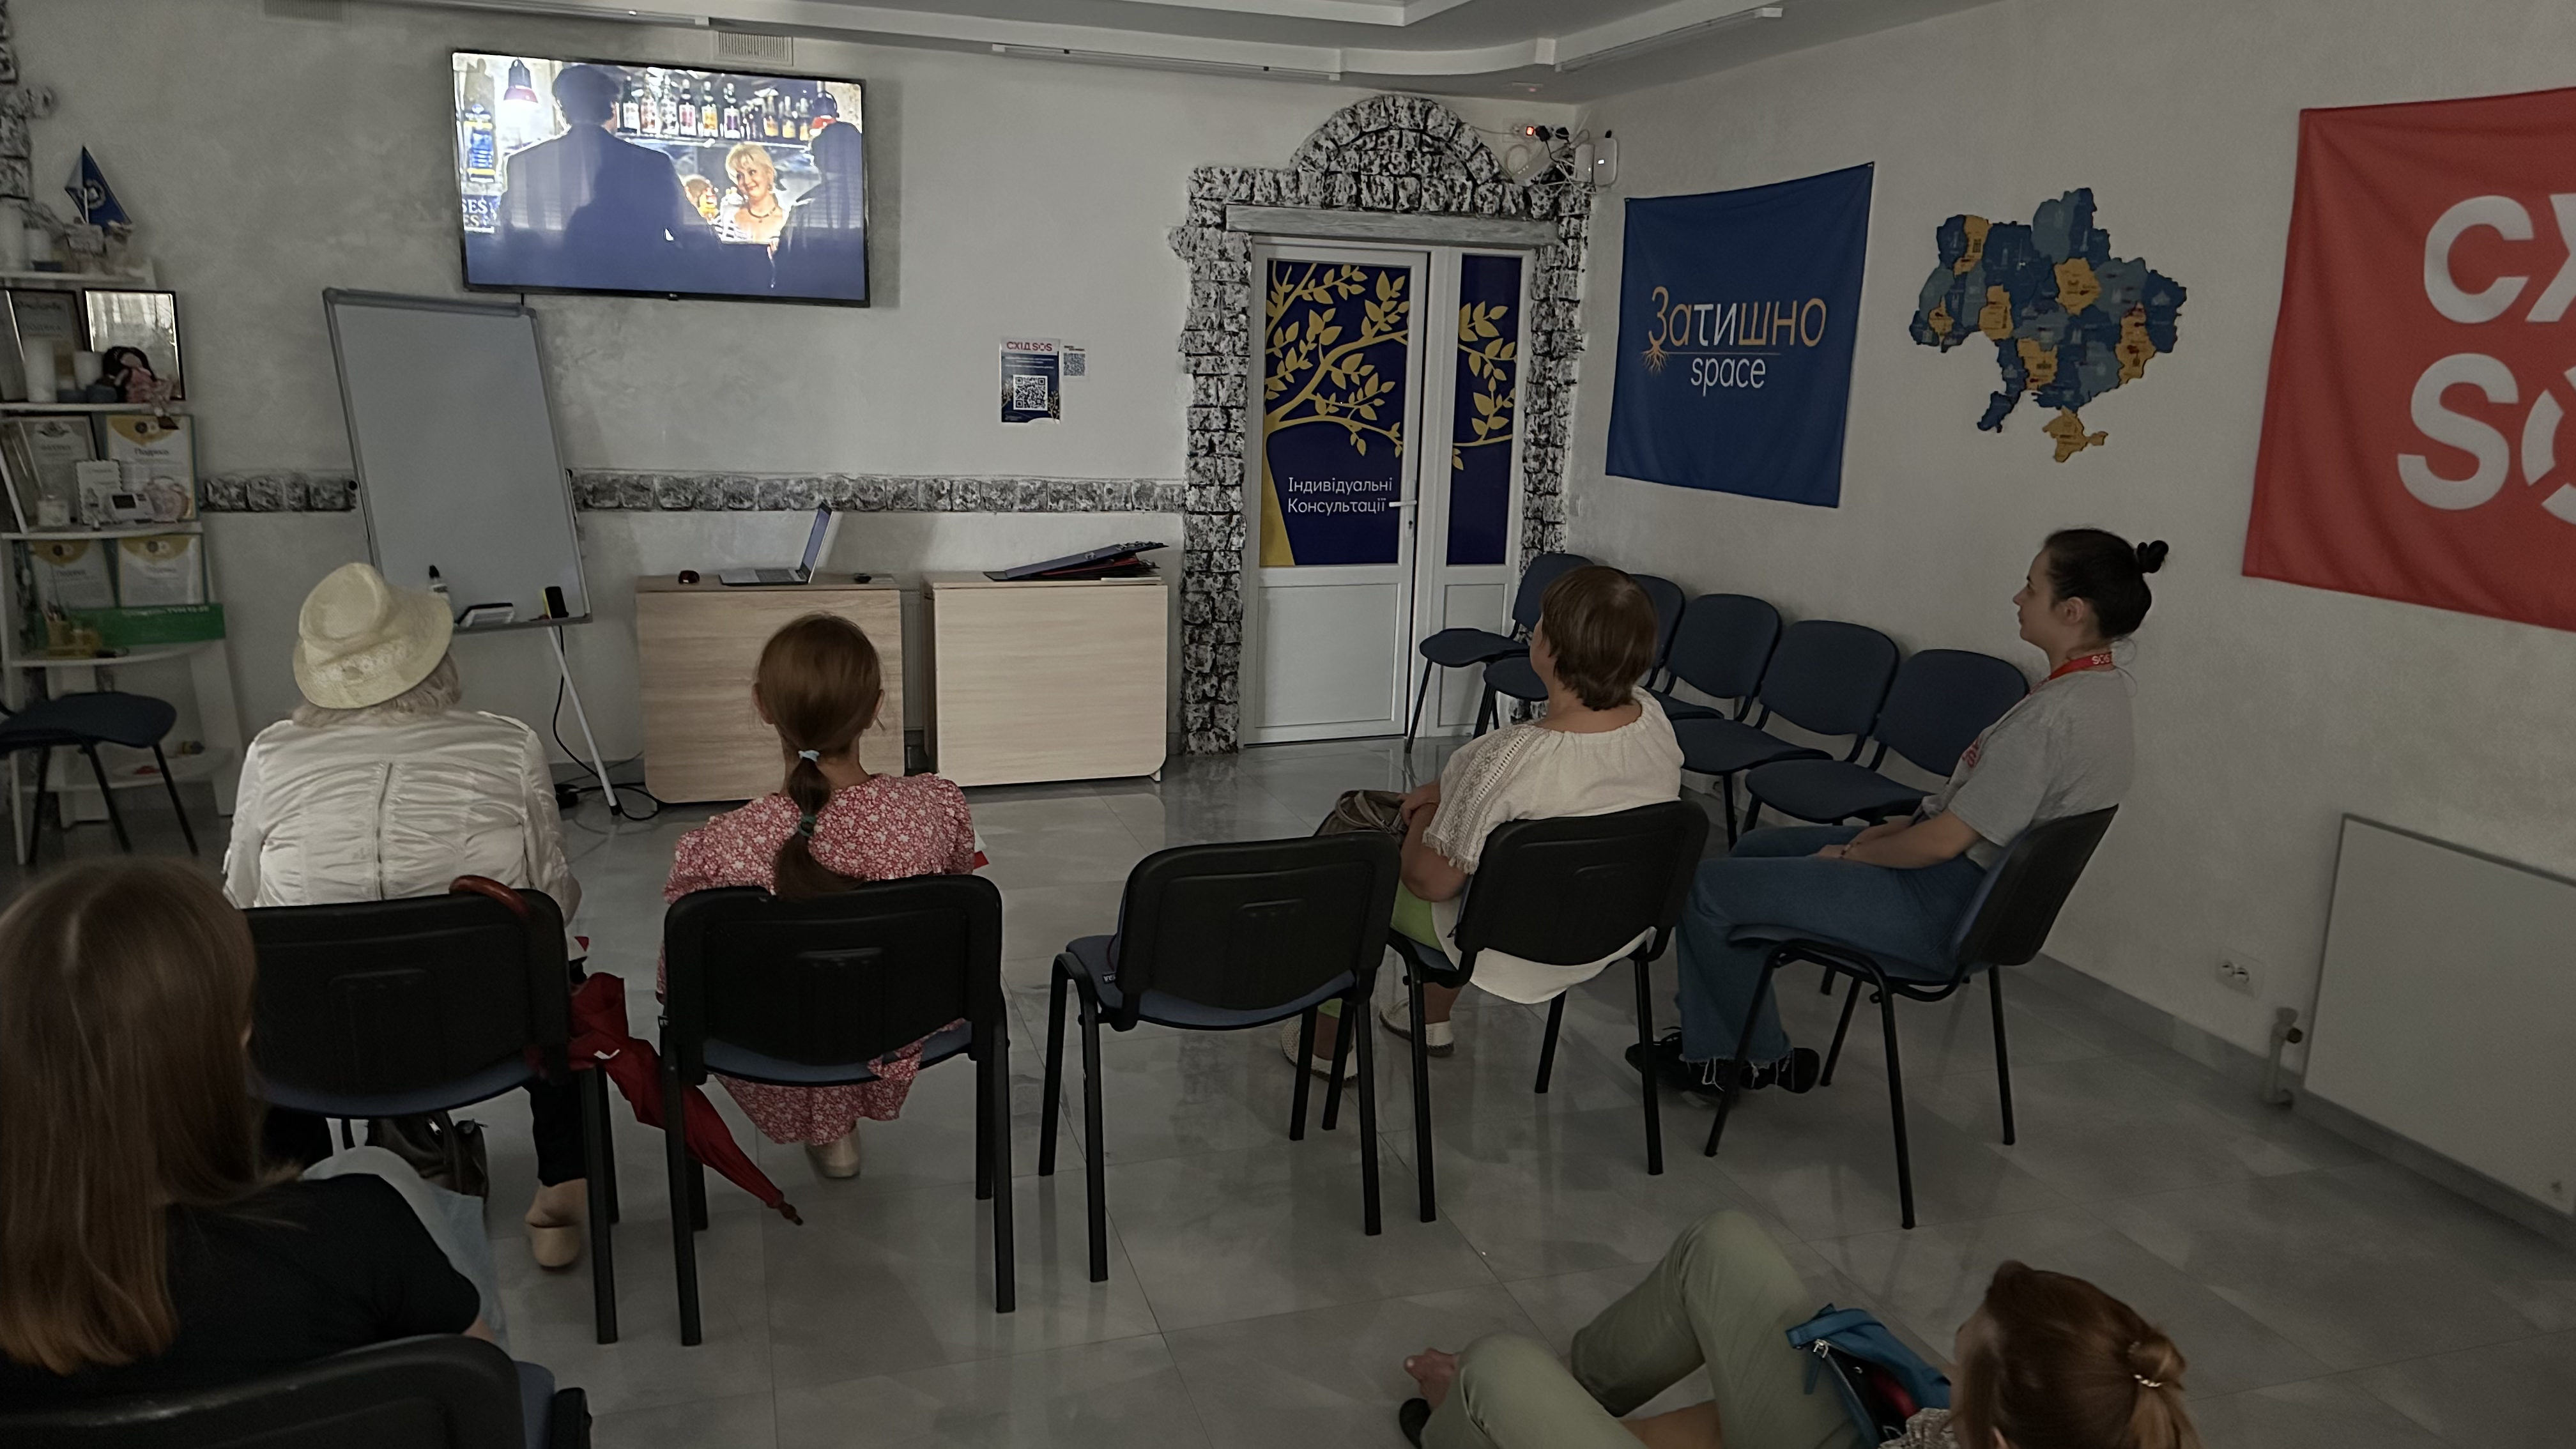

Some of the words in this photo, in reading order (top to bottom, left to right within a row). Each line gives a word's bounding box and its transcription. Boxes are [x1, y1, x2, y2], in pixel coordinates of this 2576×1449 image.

[1647, 286, 1827, 347] Затишно
[1006, 341, 1031, 351] СХІД
[1032, 342, 1053, 351] SOS
[1690, 357, 1767, 397] space
[1288, 477, 1393, 496] Індивідуальні
[1288, 497, 1386, 516] Консультації
